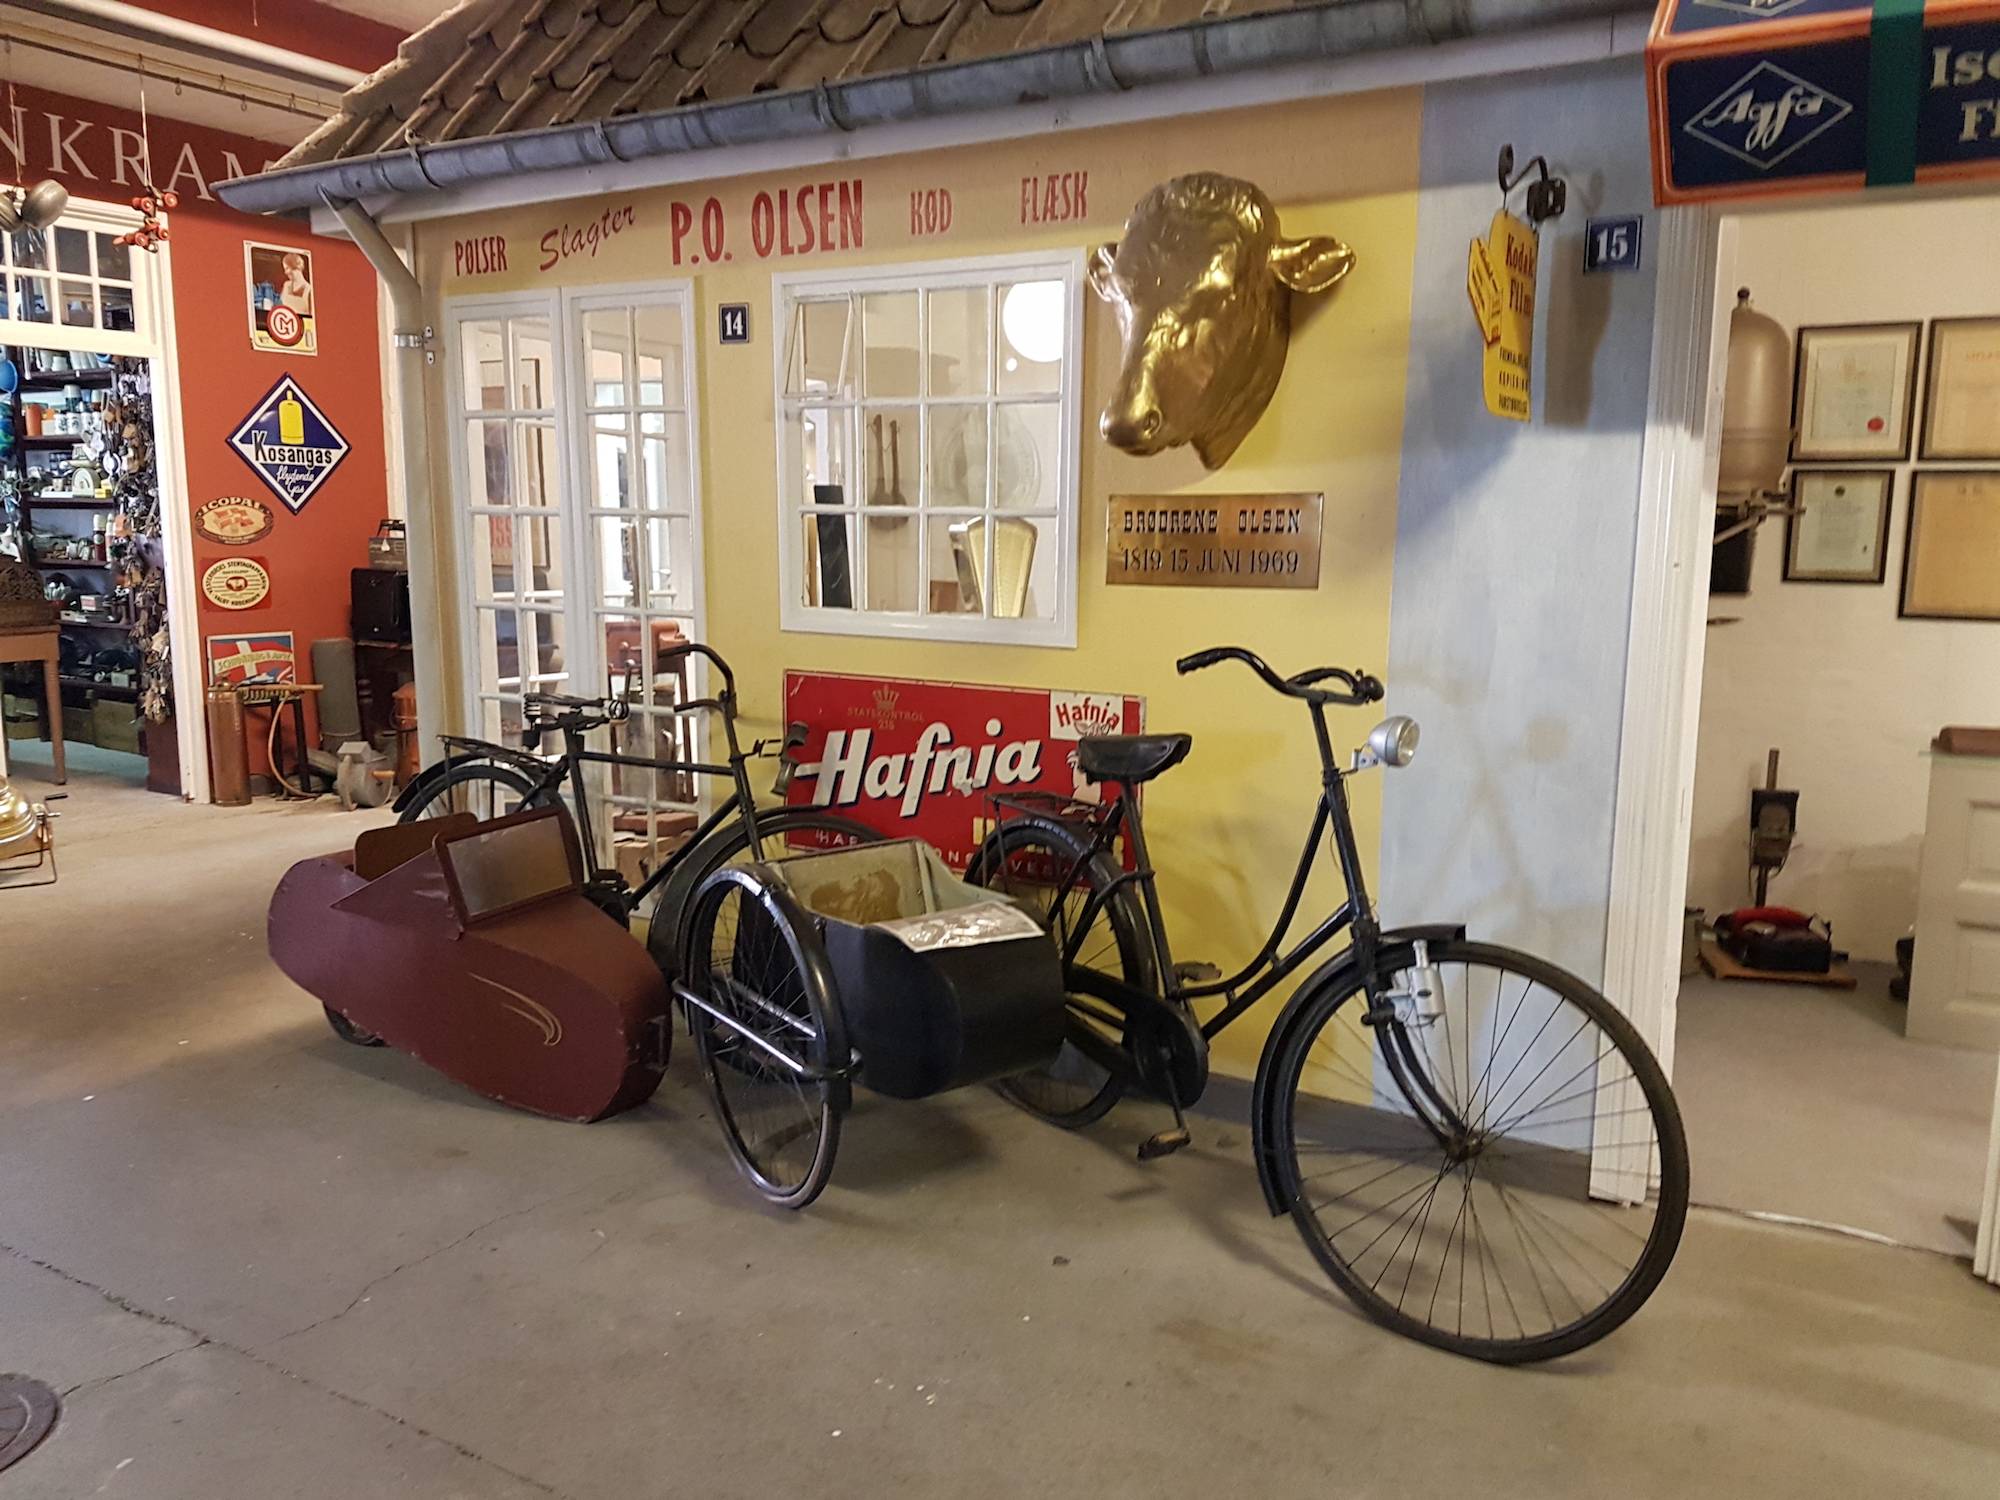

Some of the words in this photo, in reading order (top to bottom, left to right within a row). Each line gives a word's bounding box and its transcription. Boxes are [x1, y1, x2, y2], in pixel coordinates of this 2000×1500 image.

[1702, 87, 1824, 151] Agfa
[540, 205, 635, 271] Slagter
[670, 196, 733, 265] P.O.
[751, 179, 863, 258] OLSEN
[911, 188, 952, 236] KØD
[1020, 171, 1088, 224] FLÆSK
[1505, 232, 1535, 278] Kodak
[1596, 226, 1628, 262] 15
[724, 311, 744, 336] 14
[252, 430, 332, 468] Kosangas
[201, 496, 266, 514] ICOPAL
[1124, 509, 1219, 533] BRØDRENE
[1238, 509, 1301, 534] OLSEN
[1122, 548, 1163, 572] 1819
[1170, 549, 1188, 572] 15
[1196, 549, 1240, 574] JUNI
[1250, 549, 1298, 574] 1969
[1056, 696, 1120, 731] Hafnia
[795, 718, 1042, 818] Hafnia
